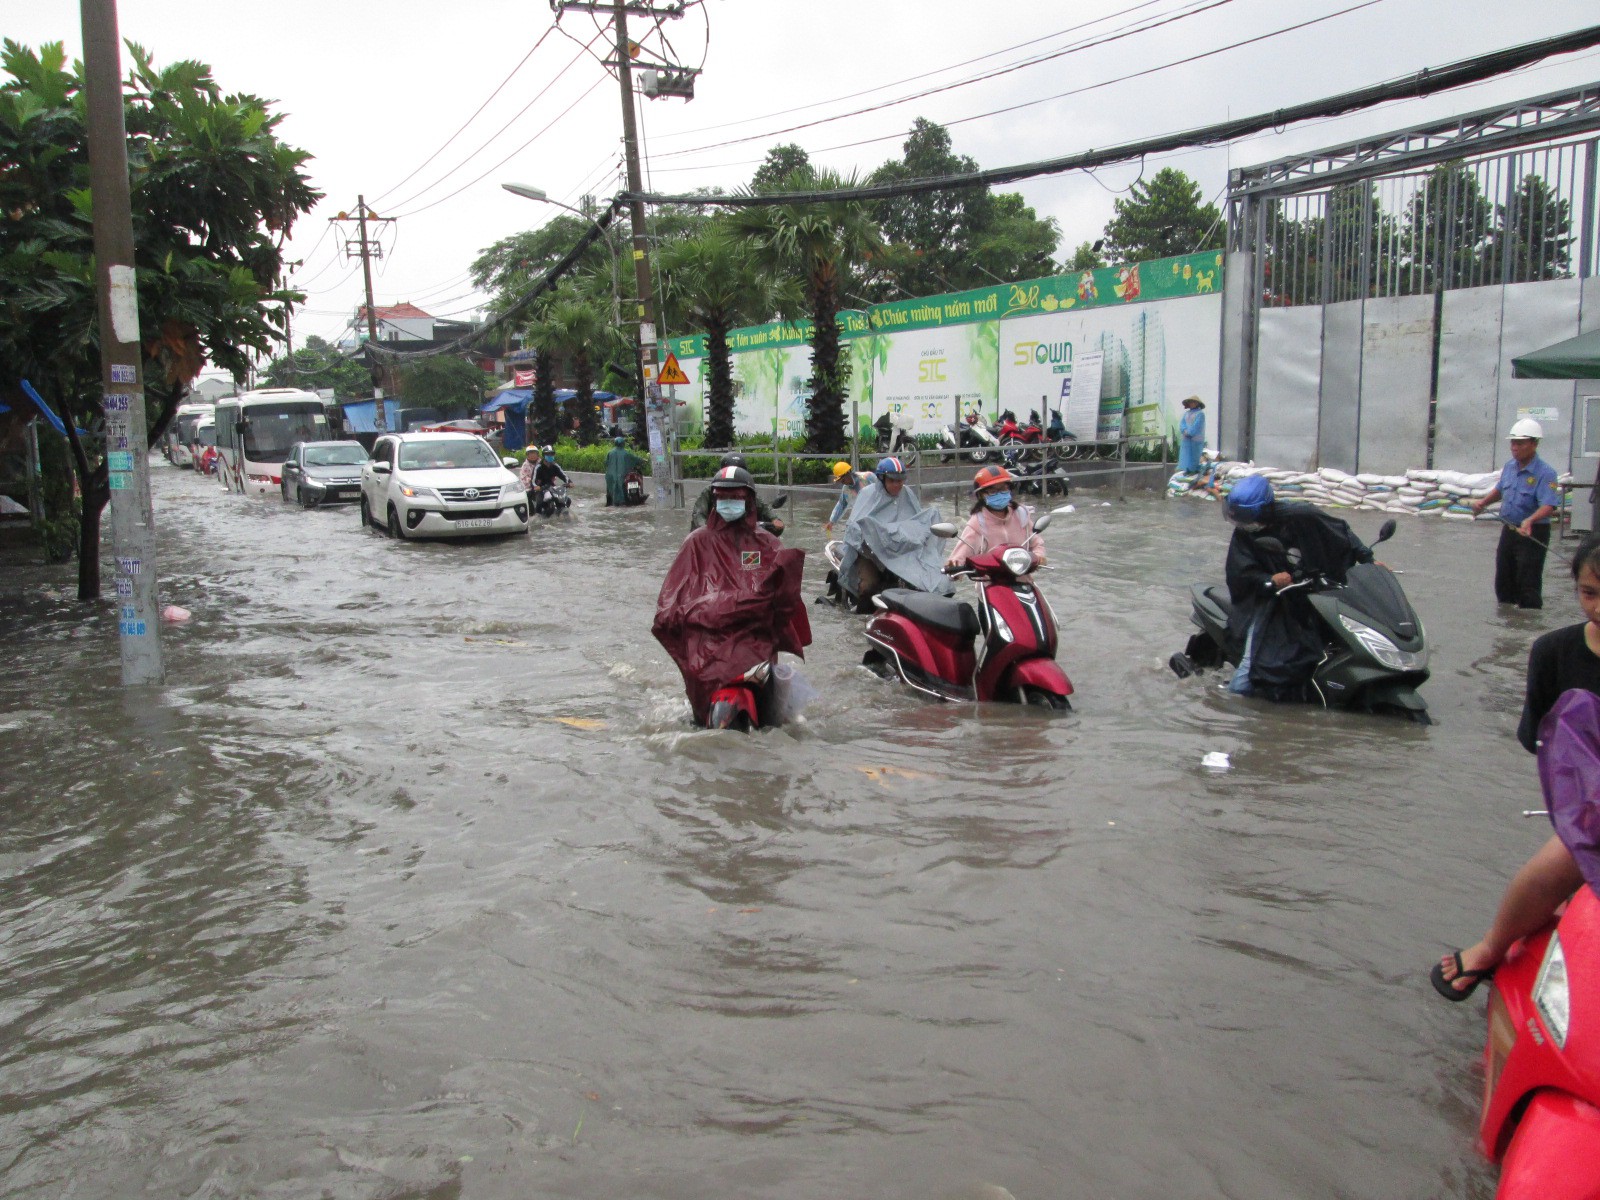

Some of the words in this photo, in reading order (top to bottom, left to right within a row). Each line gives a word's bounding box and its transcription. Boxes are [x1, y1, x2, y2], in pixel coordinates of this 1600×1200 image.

[882, 308, 909, 325] Chúc
[911, 305, 942, 324] mừng
[945, 300, 971, 318] năm
[974, 293, 998, 313] mới
[1008, 284, 1040, 309] 2018
[918, 358, 948, 383] STC
